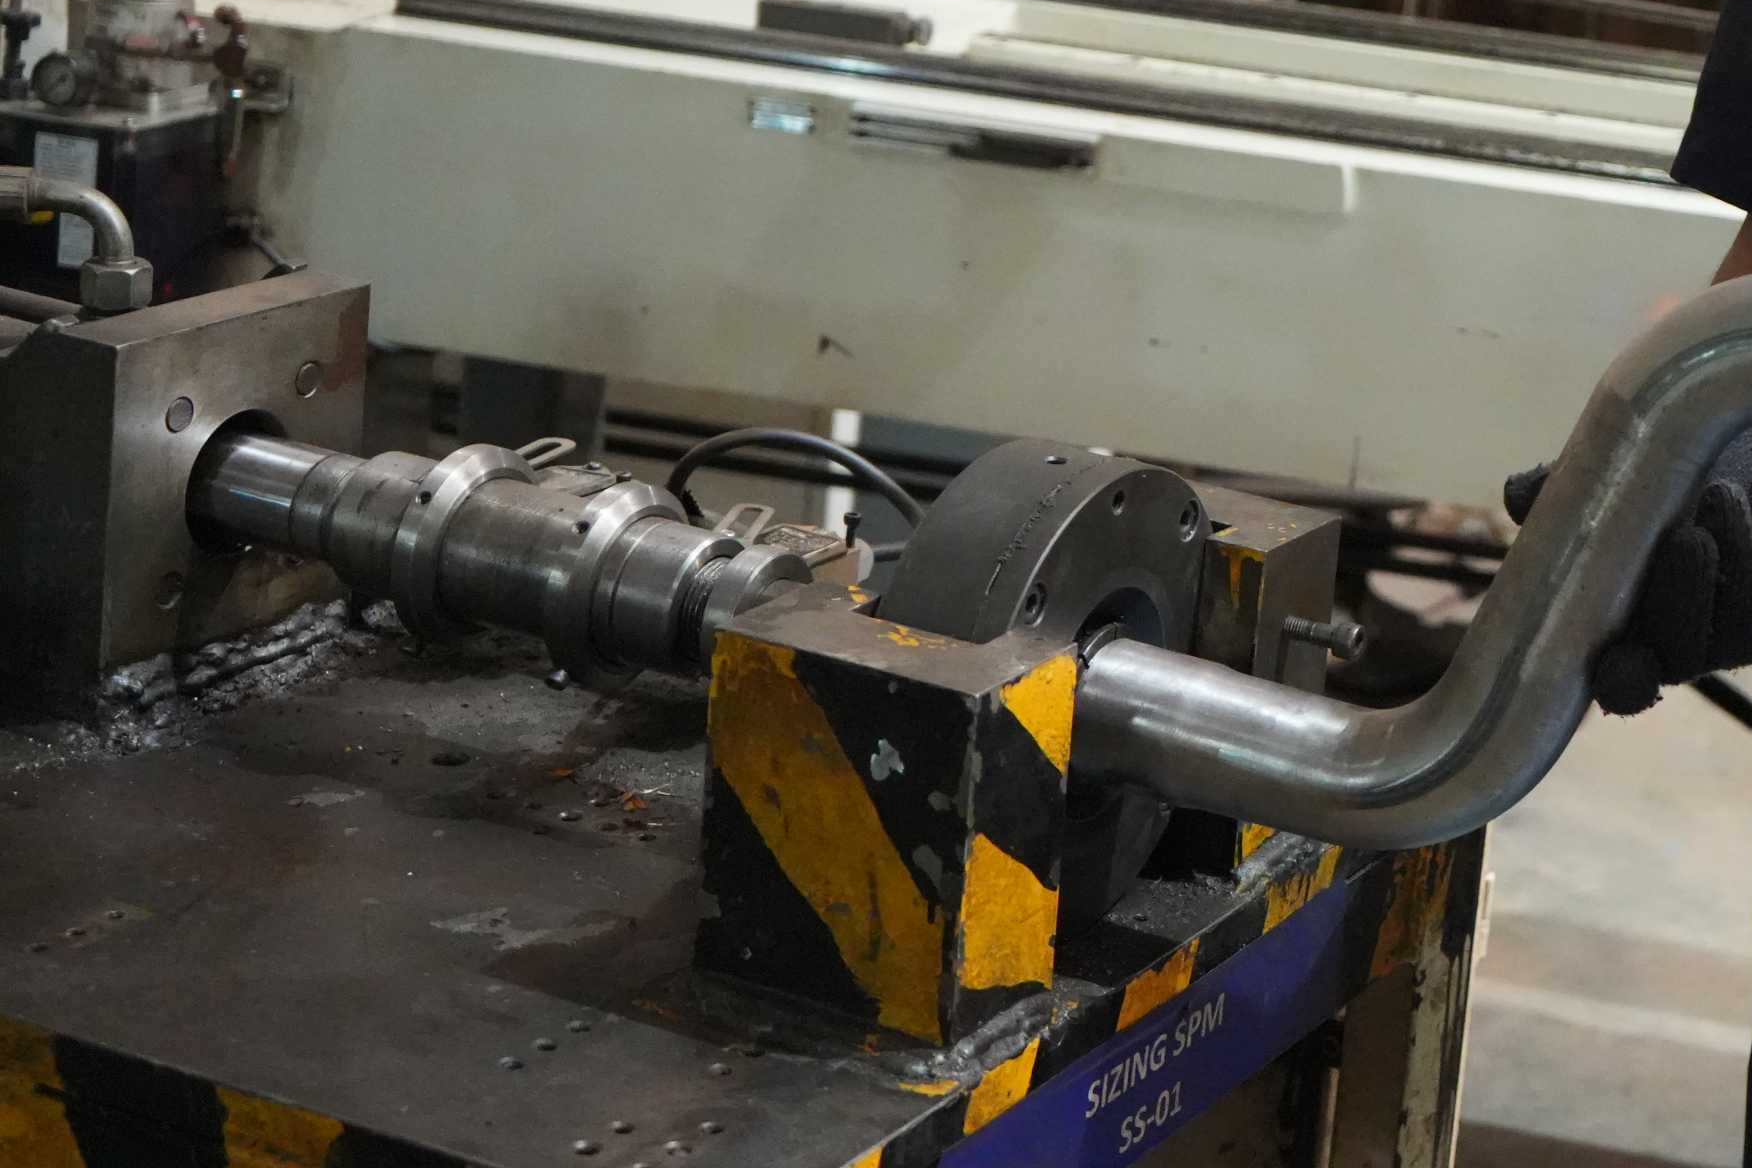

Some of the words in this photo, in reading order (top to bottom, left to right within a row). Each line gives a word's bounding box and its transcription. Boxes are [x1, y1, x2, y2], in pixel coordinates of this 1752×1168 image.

[1085, 1033, 1168, 1119] SIZING
[1172, 992, 1225, 1057] SPM
[1119, 1081, 1183, 1154] SS-01
